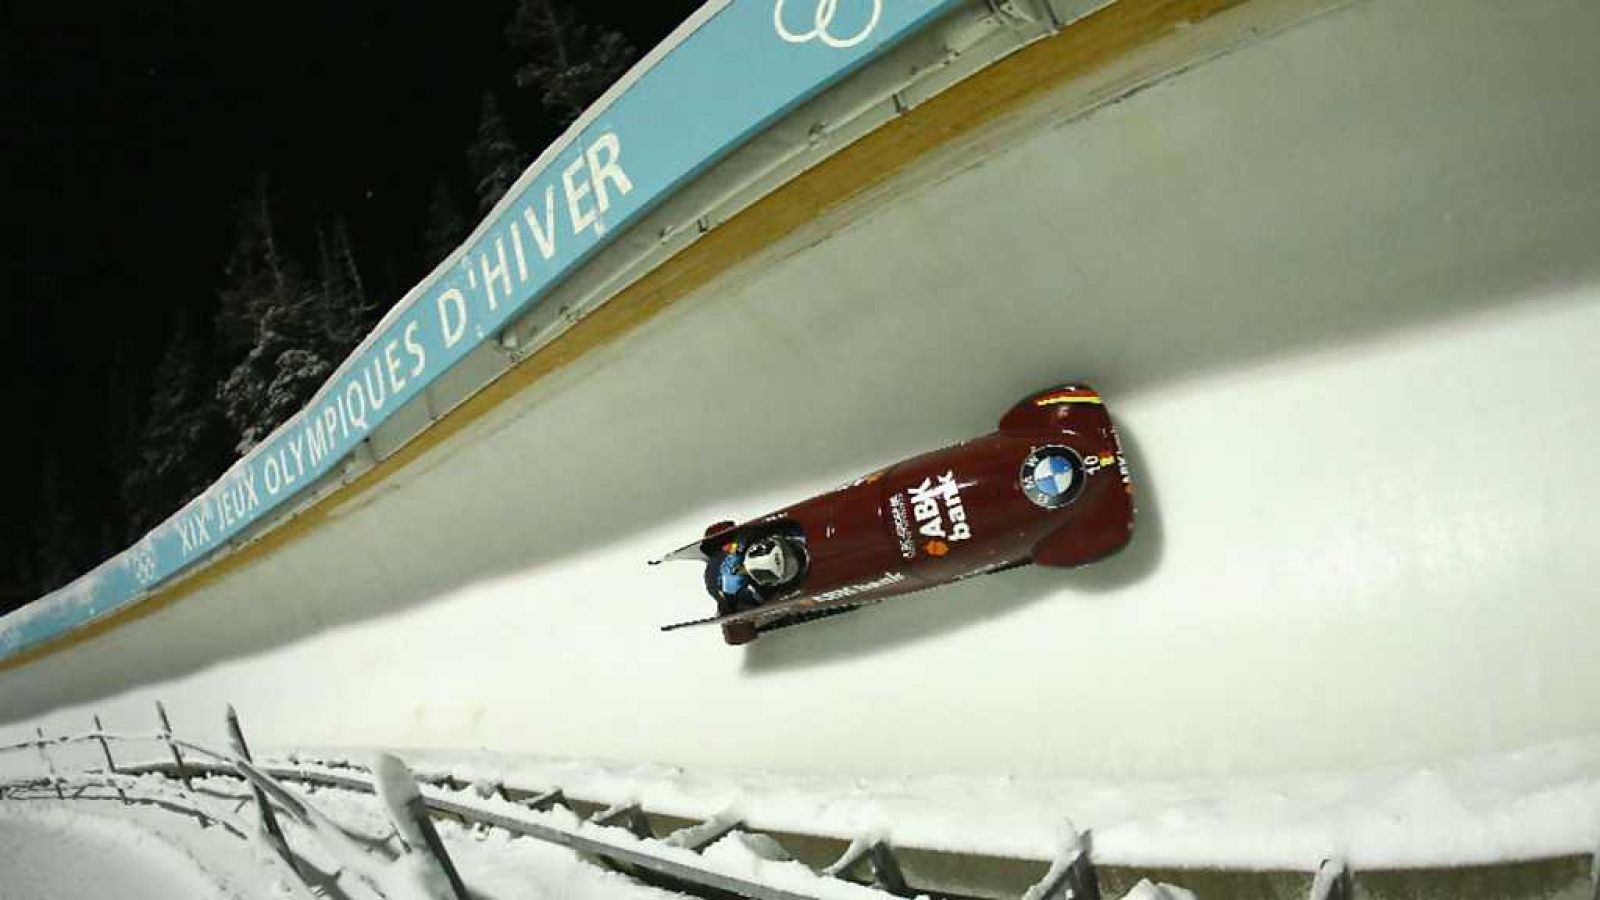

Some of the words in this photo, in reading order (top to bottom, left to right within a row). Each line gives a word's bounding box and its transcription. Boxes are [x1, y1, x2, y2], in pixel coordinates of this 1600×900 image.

[217, 471, 259, 532] JEUX
[263, 321, 426, 495] OLYMPIQUES
[437, 132, 633, 348] D'HIVER
[1083, 455, 1100, 475] 10
[908, 477, 946, 538] ABK
[938, 470, 972, 541] bank
